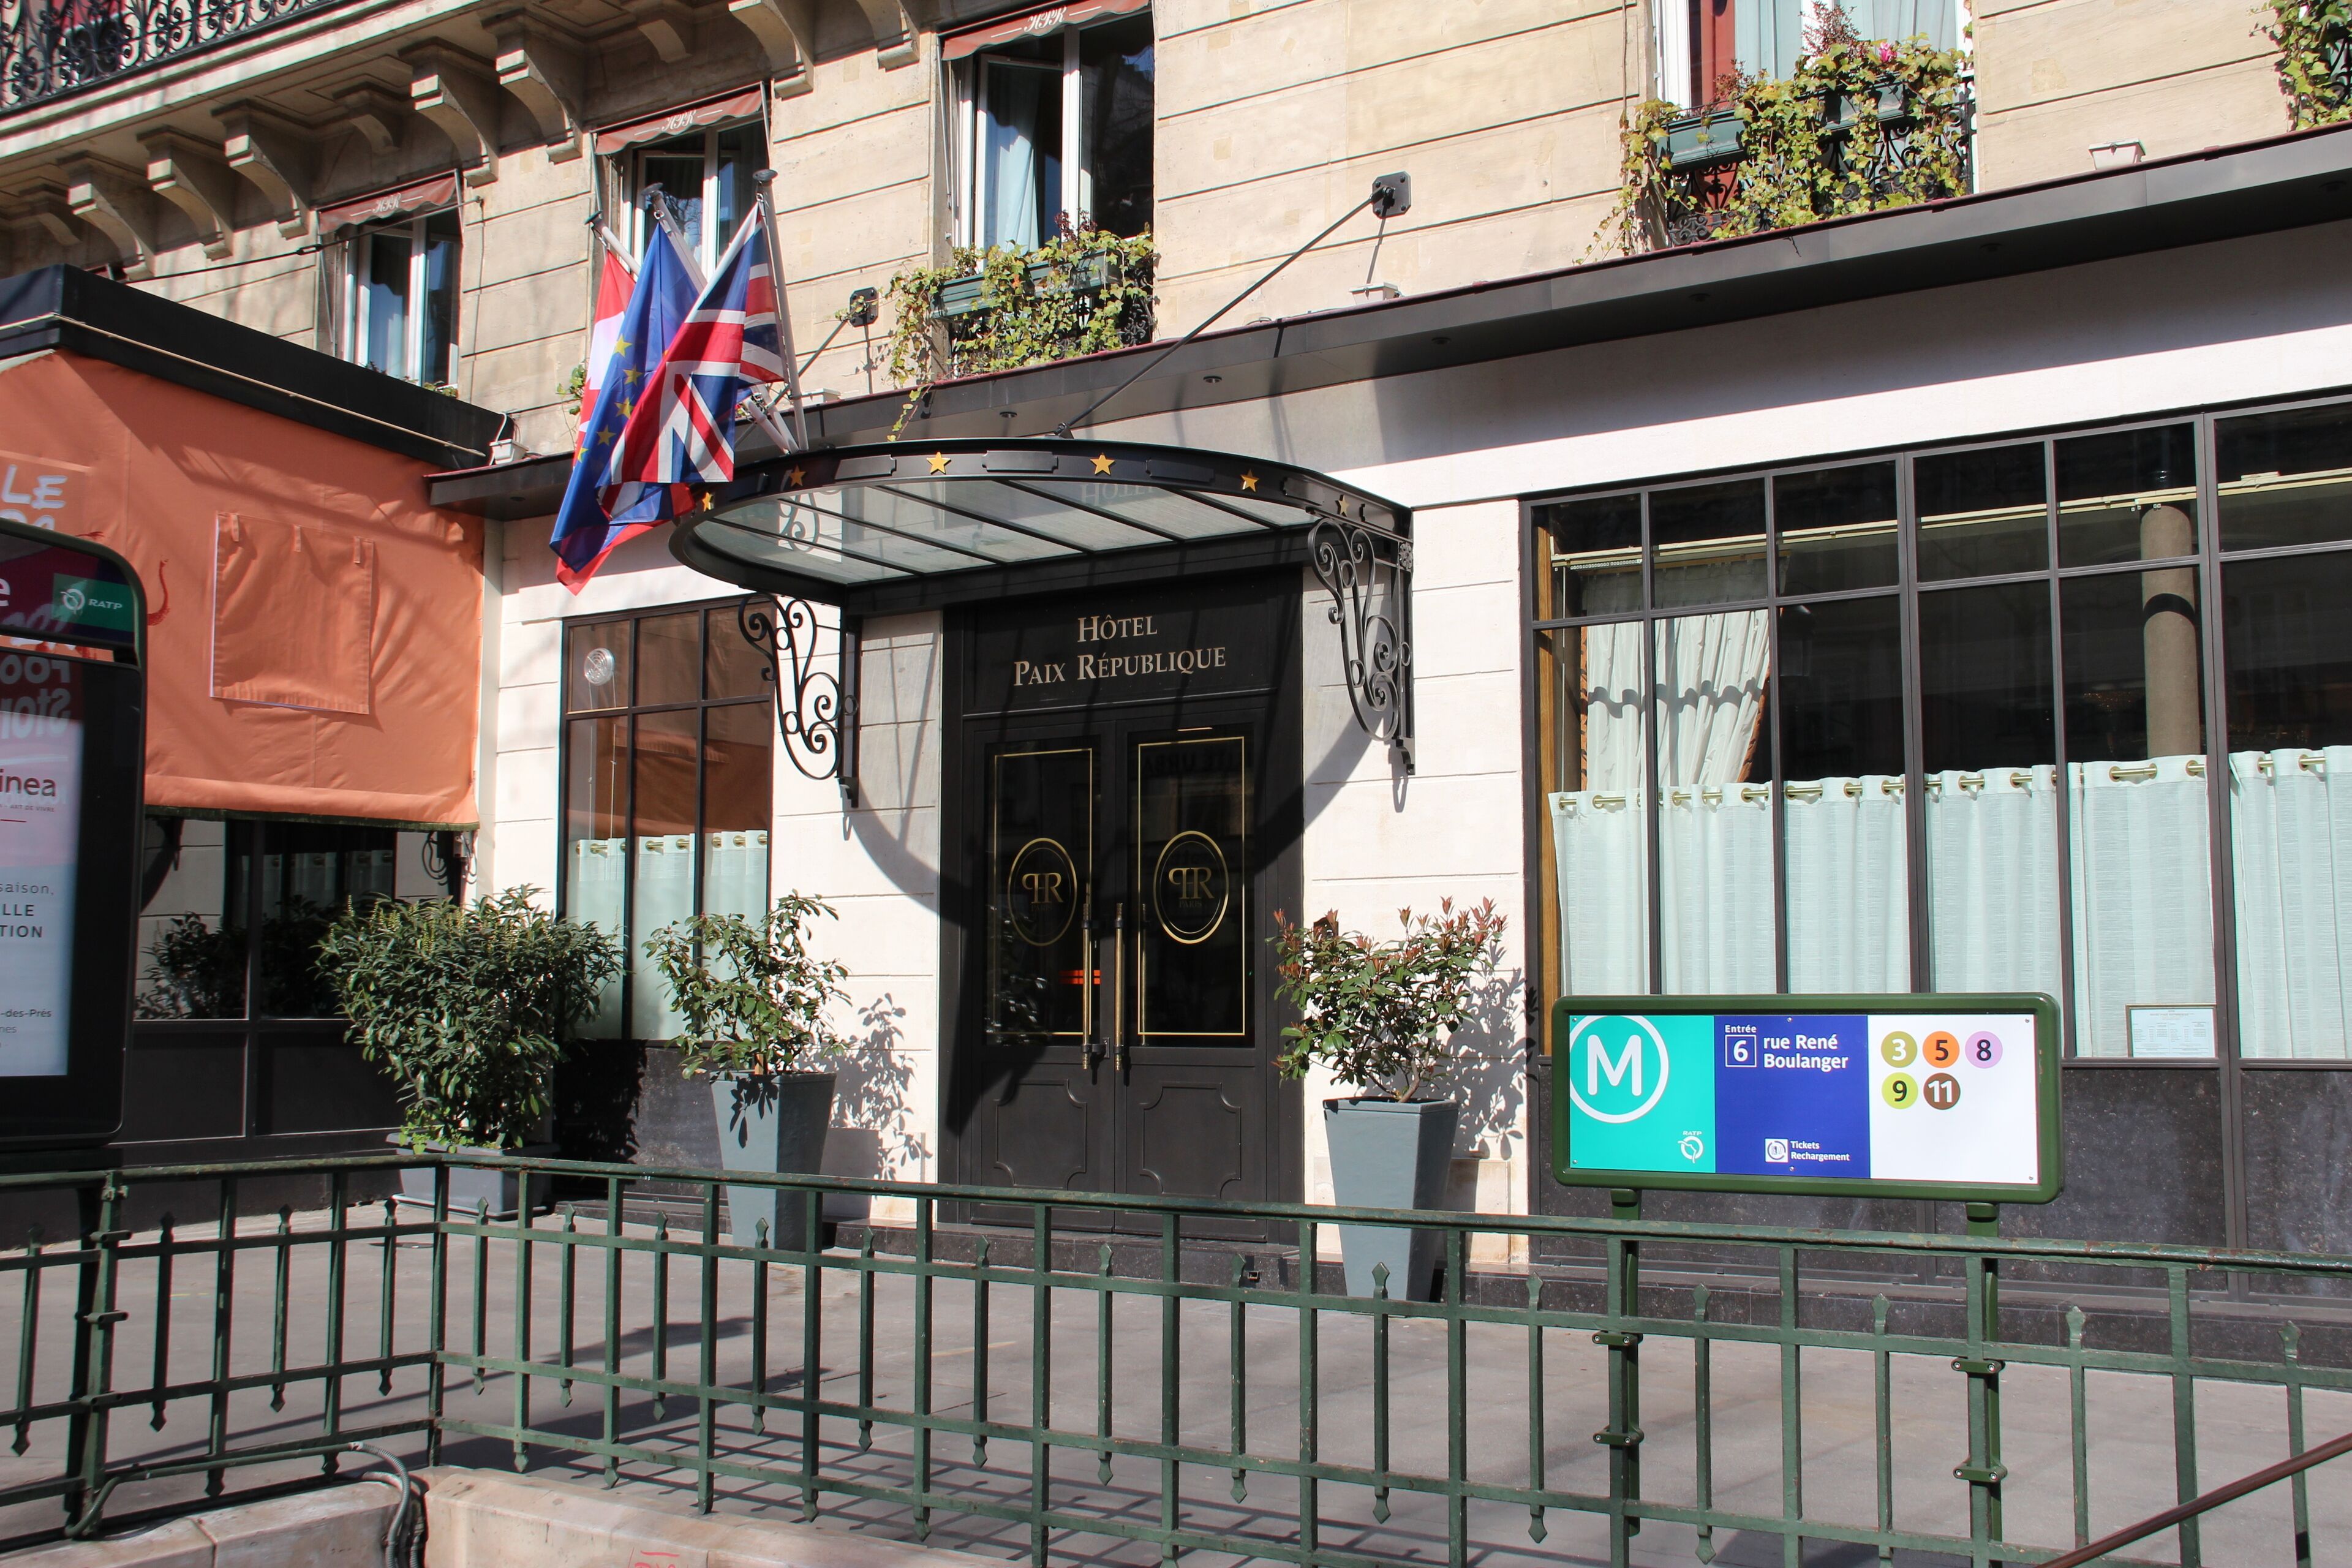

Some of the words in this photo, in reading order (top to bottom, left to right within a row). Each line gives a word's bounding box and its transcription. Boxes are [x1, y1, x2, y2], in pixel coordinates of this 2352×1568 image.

[88, 598, 123, 610] RATP
[1077, 614, 1158, 643] HÔTEL
[1014, 660, 1066, 687] PAIX
[1077, 647, 1227, 680] RÉPUBLIQUE
[1725, 1025, 1757, 1033] Entrée
[1733, 1040, 1749, 1062] 6
[1763, 1037, 1790, 1049] rue
[1795, 1033, 1838, 1050] René
[1891, 1038, 1907, 1061] 3
[1934, 1039, 1949, 1061] 5
[1976, 1039, 1992, 1061] 8
[1587, 1035, 1642, 1096] M
[1763, 1053, 1849, 1072] Boulanger
[1892, 1080, 1908, 1102] 9
[1928, 1080, 1953, 1103] 11
[1790, 1140, 1820, 1150] Tickets
[1790, 1151, 1850, 1163] Rechargement
